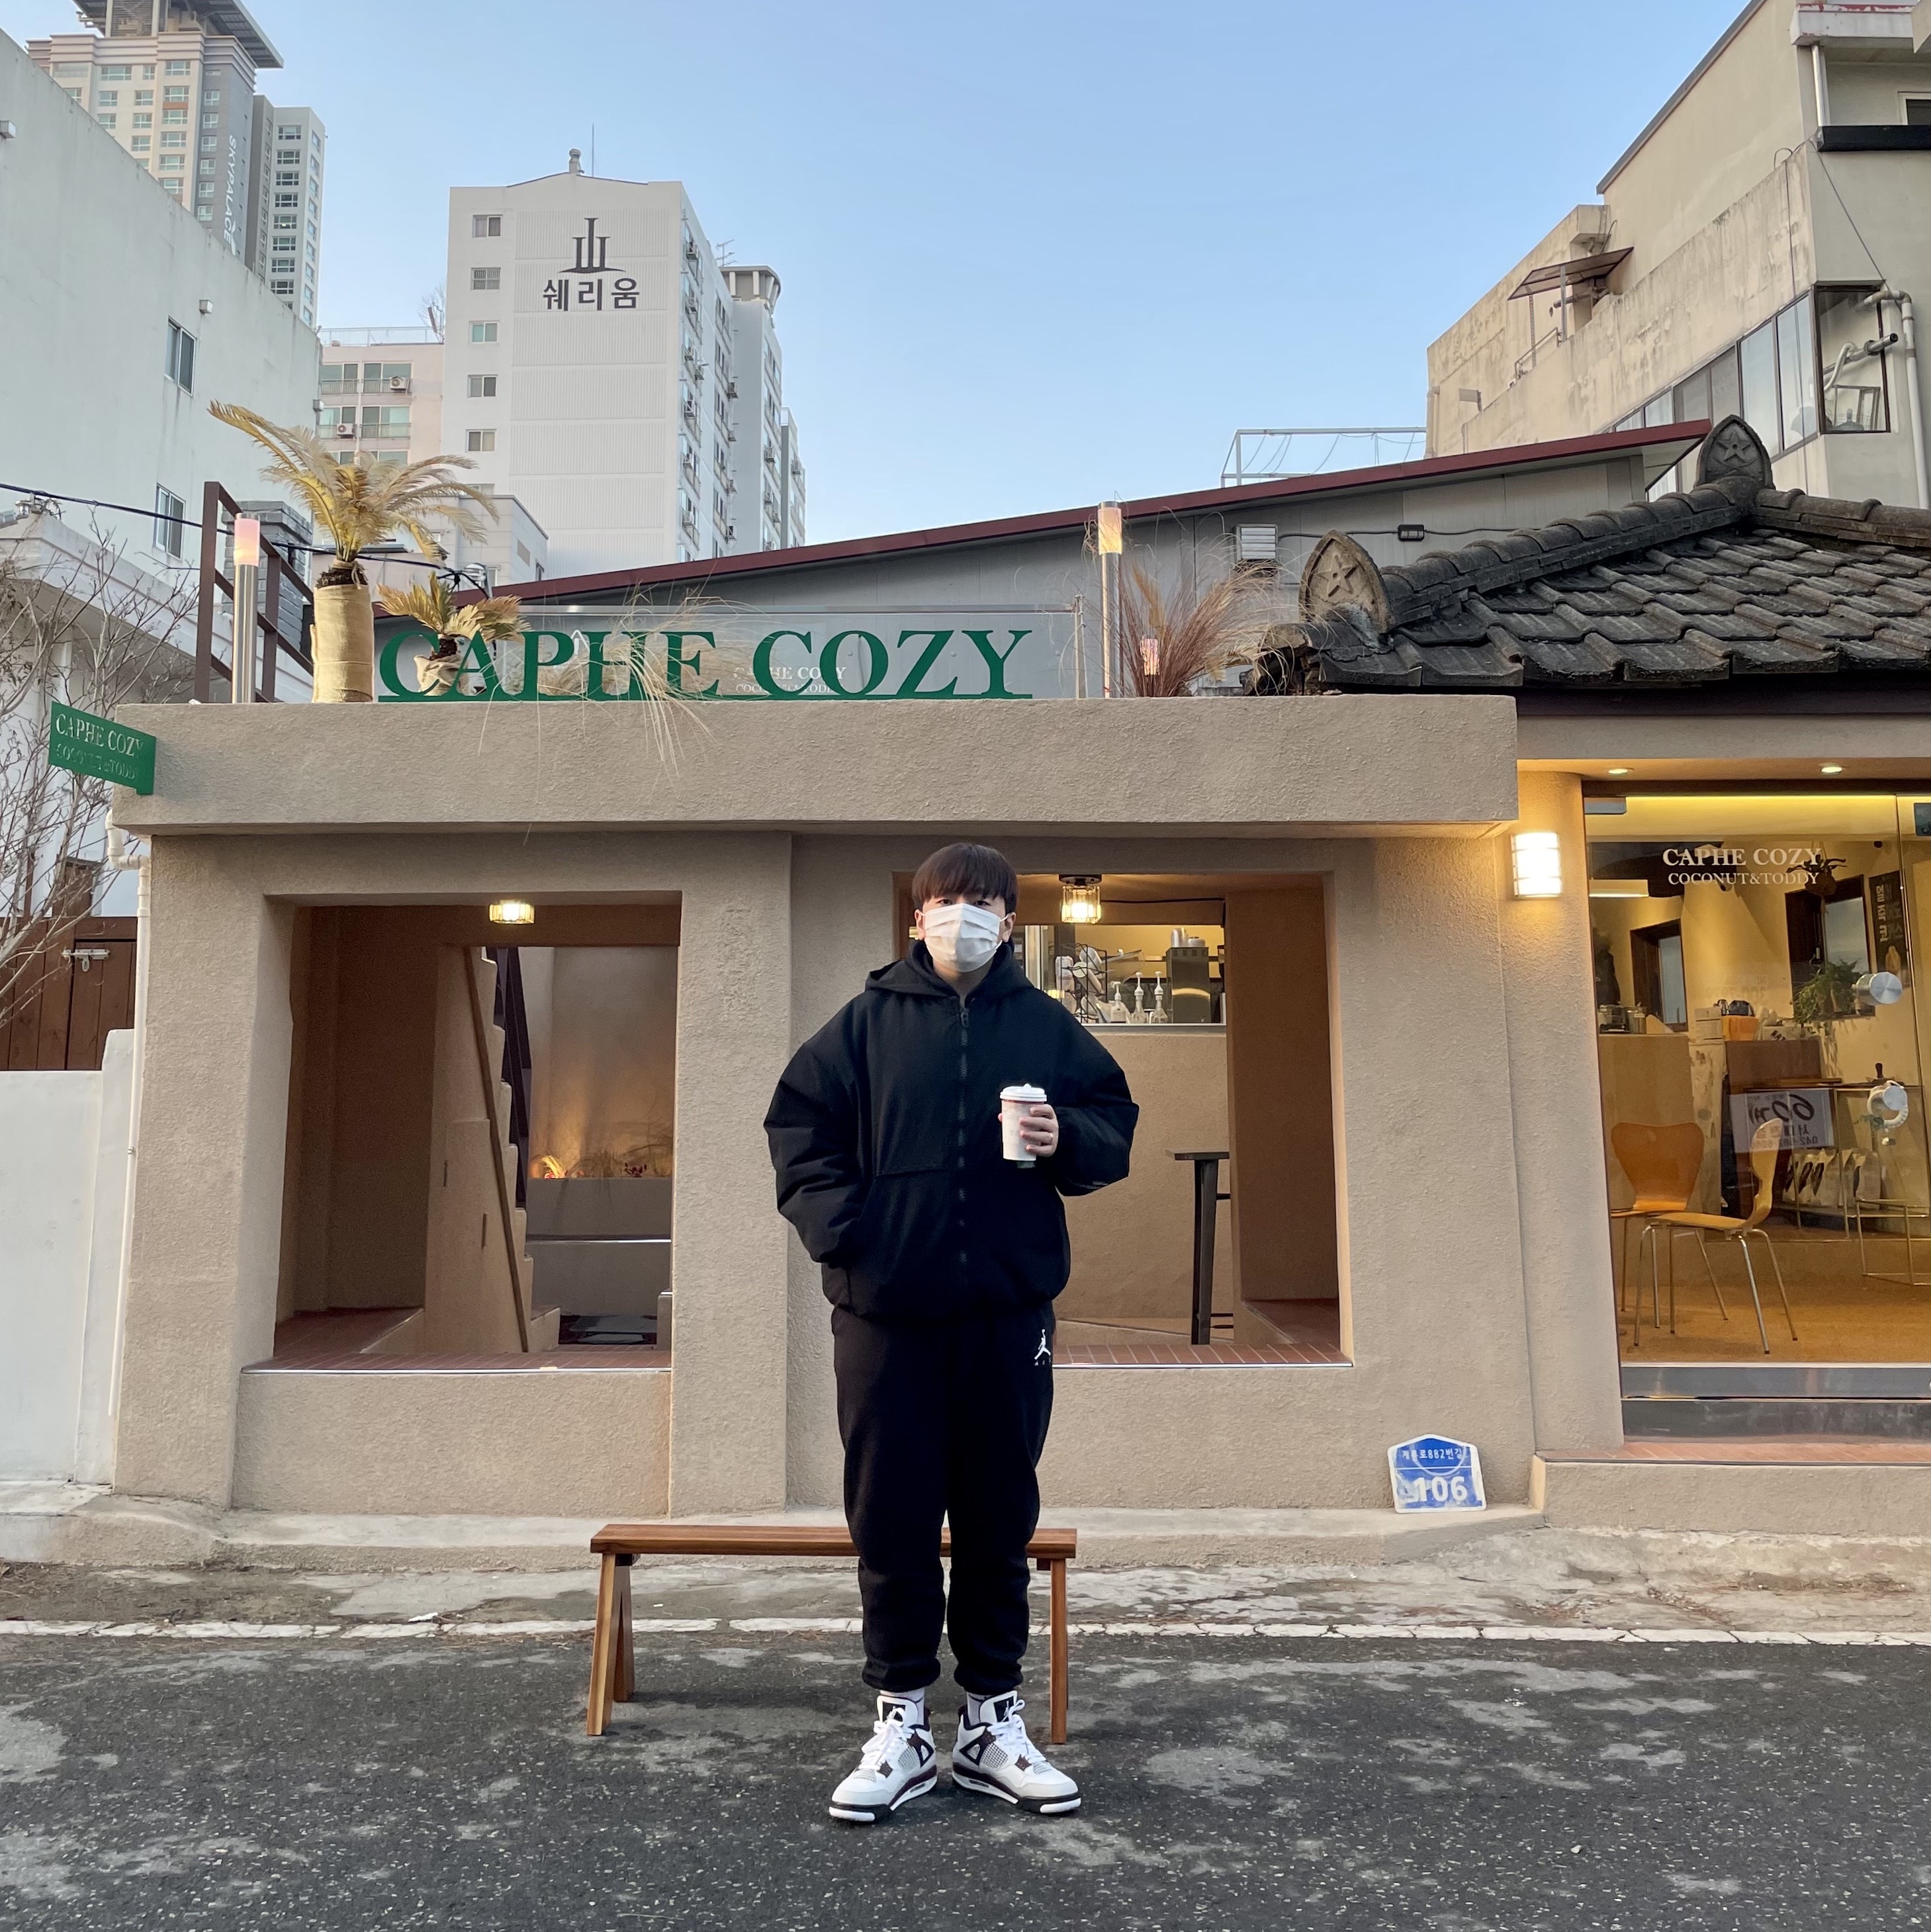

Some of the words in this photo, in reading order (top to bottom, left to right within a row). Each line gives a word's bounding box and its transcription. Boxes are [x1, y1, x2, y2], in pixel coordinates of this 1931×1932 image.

[224, 135, 237, 244] SKYPALACE
[543, 278, 640, 311] 쉐리움
[379, 630, 719, 696] CAPHE
[753, 630, 1032, 696] COZY
[797, 667, 846, 679] COY
[56, 713, 104, 747] CAPHE
[108, 730, 144, 758] COZY
[1662, 848, 1747, 866] CAPHE
[1753, 847, 1821, 866] COZY
[1668, 872, 1820, 886] COCONUT&TODDY
[1414, 1475, 1468, 1502] 106
